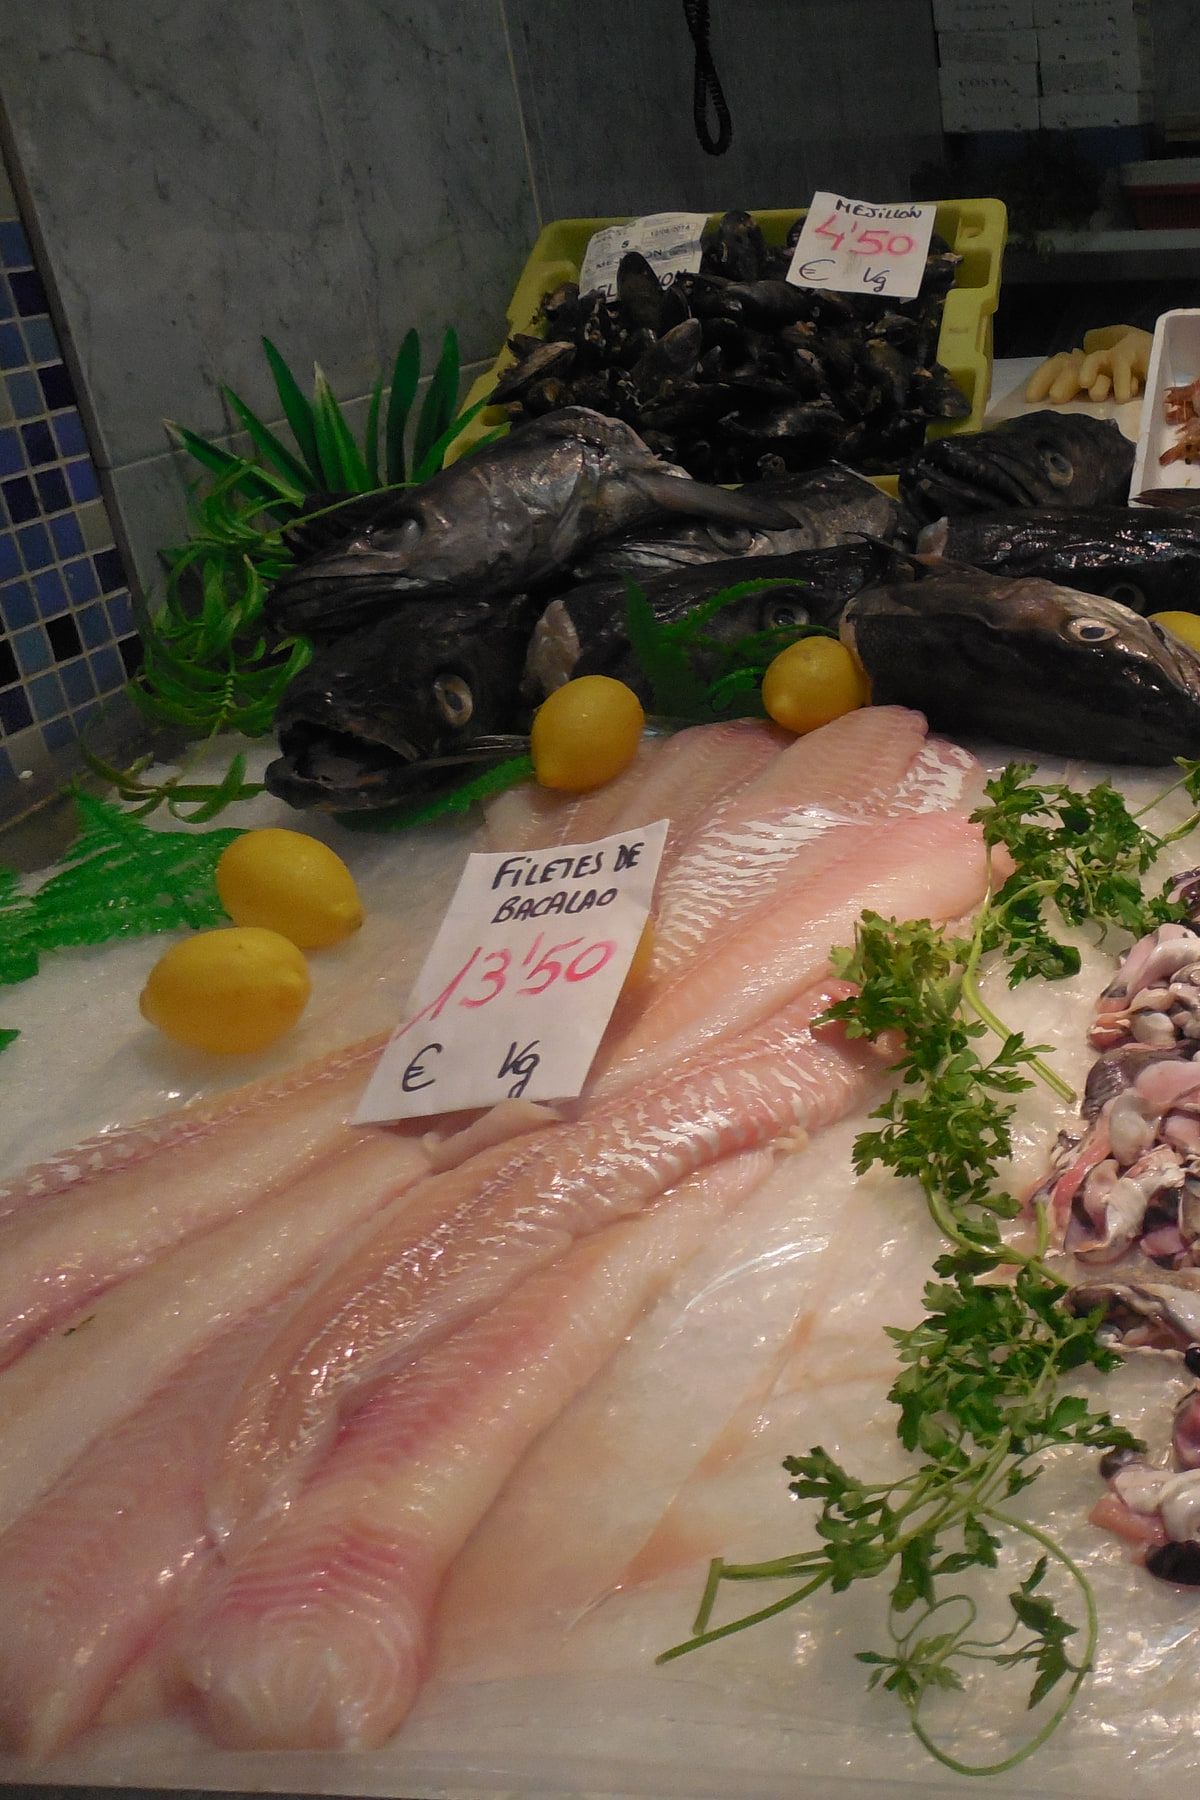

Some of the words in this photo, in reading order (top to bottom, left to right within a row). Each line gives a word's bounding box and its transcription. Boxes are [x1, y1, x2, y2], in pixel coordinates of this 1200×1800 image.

[814, 213, 915, 256] 4'50
[799, 258, 836, 281] €
[614, 842, 645, 872] DE
[490, 888, 619, 924] BACALAO
[395, 931, 618, 1041] 13'50
[401, 1042, 443, 1093] €
